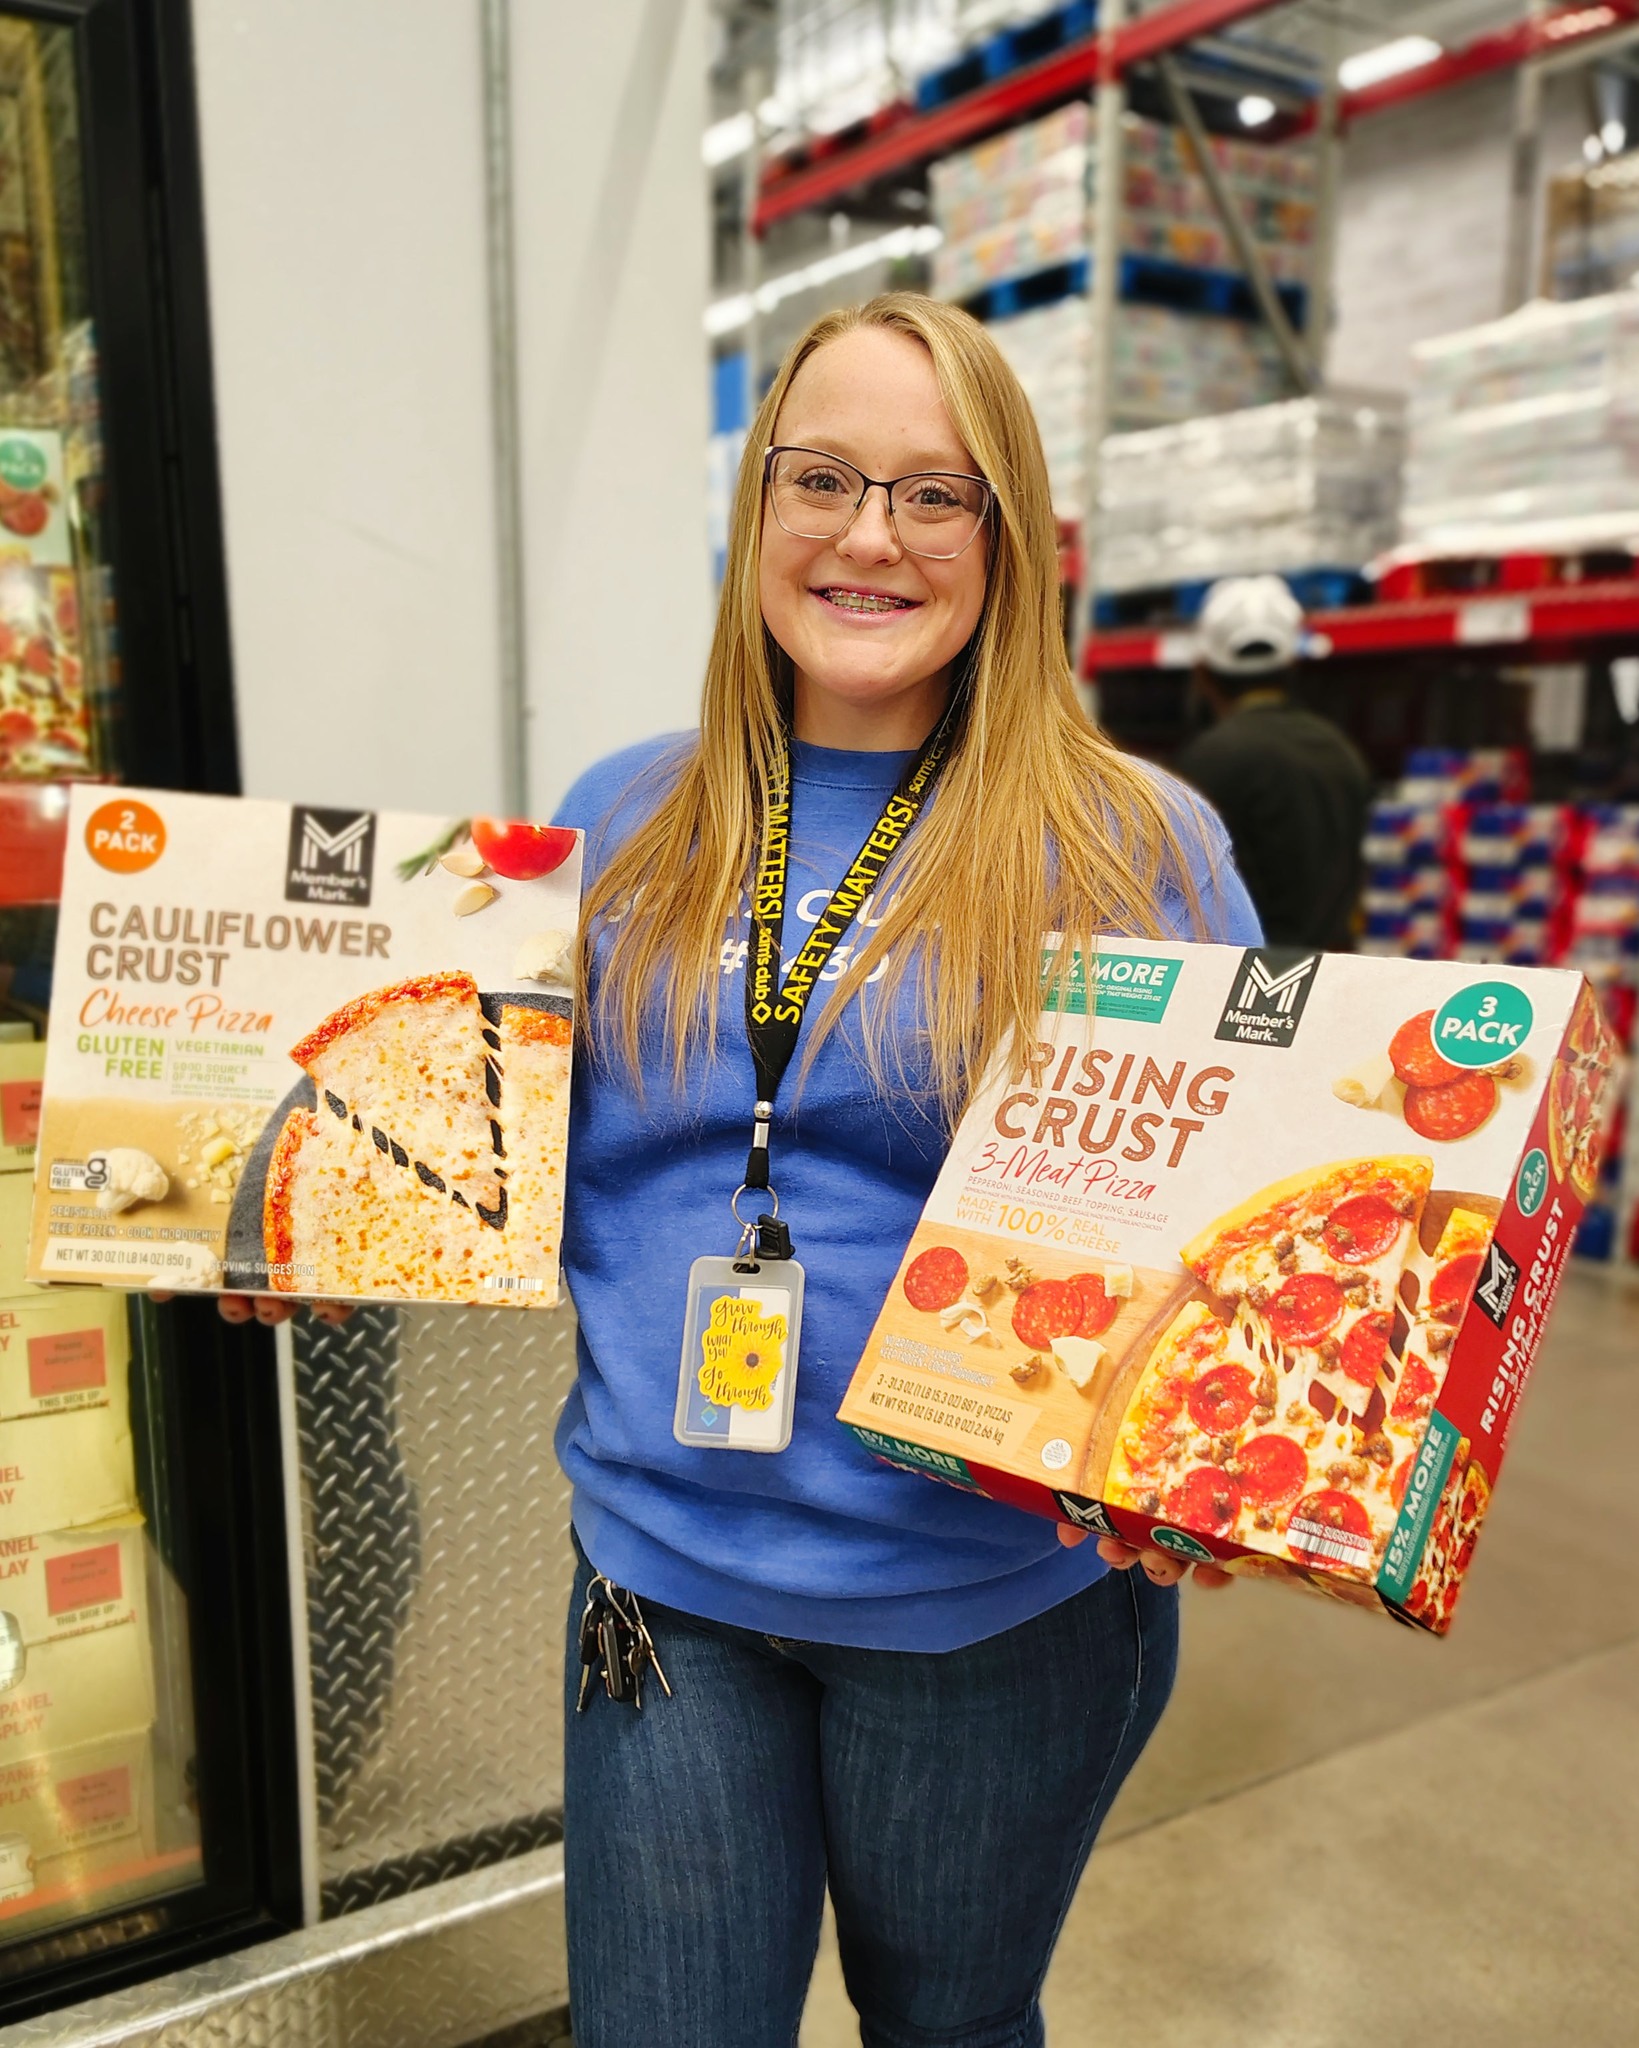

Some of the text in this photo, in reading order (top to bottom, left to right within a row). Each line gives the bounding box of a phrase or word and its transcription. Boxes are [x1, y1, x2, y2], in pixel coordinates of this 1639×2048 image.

[119, 809, 136, 831] 2
[94, 829, 157, 854] PACK
[290, 869, 367, 890] Member's
[774, 794, 919, 1024] SAFETY MATTERS!
[89, 902, 392, 959] CAULIFLOWER
[86, 943, 230, 987] CRUST
[755, 927, 773, 1000] sam's club
[1091, 959, 1169, 987] MORE
[79, 988, 274, 1034] Cheese Pizza
[1477, 995, 1499, 1018] 3
[1224, 1010, 1295, 1030] Member's
[1440, 1017, 1523, 1047] PACK
[77, 1034, 165, 1058] GLUTEN
[174, 1040, 265, 1057] VEGETARIAN
[105, 1058, 163, 1080] FREE
[189, 1074, 236, 1084] PROTEIN
[206, 1064, 249, 1075] SOURCE
[1010, 1041, 1236, 1116] RISING
[994, 1092, 1206, 1168] CRUST
[51, 1177, 72, 1188] FREE
[52, 1167, 86, 1178] GLUTEN
[971, 1142, 1157, 1202] 3-Meat Pizza
[1523, 1170, 1533, 1183] 3
[1523, 1158, 1546, 1211] PACK
[957, 1194, 998, 1212] MADE
[967, 1175, 1169, 1223] PEPPERONI, SEASONED BEEF TOPPING, SAUSAGE
[51, 1205, 112, 1219] PERISHABLE
[956, 1207, 993, 1226] WITH
[997, 1204, 1068, 1241] 100%
[49, 1222, 223, 1241] KEEP FROZEN COOK THOROUGHLY
[1072, 1218, 1106, 1236] REAL
[1067, 1232, 1121, 1254] CHEESE
[56, 1248, 74, 1261] NET
[75, 1249, 90, 1261] WT
[91, 1250, 103, 1262] 30
[105, 1251, 117, 1264] OZ
[127, 1253, 138, 1265] LB
[139, 1253, 149, 1265] 14
[150, 1253, 165, 1266] OZ)
[166, 1253, 184, 1266] 850
[185, 1256, 192, 1269] g
[254, 1262, 315, 1276] SUGGESTION
[714, 1300, 754, 1328] grow
[1480, 1314, 1526, 1435] RISING
[1522, 1197, 1564, 1309] CRUST
[731, 1315, 788, 1341] through
[708, 1347, 728, 1362] you
[703, 1365, 724, 1391] go
[715, 1381, 769, 1406] through
[904, 1381, 914, 1393] OZ
[921, 1386, 932, 1399] LB
[931, 1389, 948, 1403] 15.3
[947, 1394, 962, 1407] OZ)
[961, 1398, 978, 1412] 887
[983, 1404, 1013, 1422] PIZZAS
[870, 1392, 1005, 1443] NET WT 93.9 OZ (5 LB 13.9 OZ) 2.66 kg
[895, 1439, 962, 1473] MORE
[1384, 1526, 1411, 1577] 15%
[1404, 1424, 1443, 1521] MORE
[79, 1607, 102, 1621] SIDE
